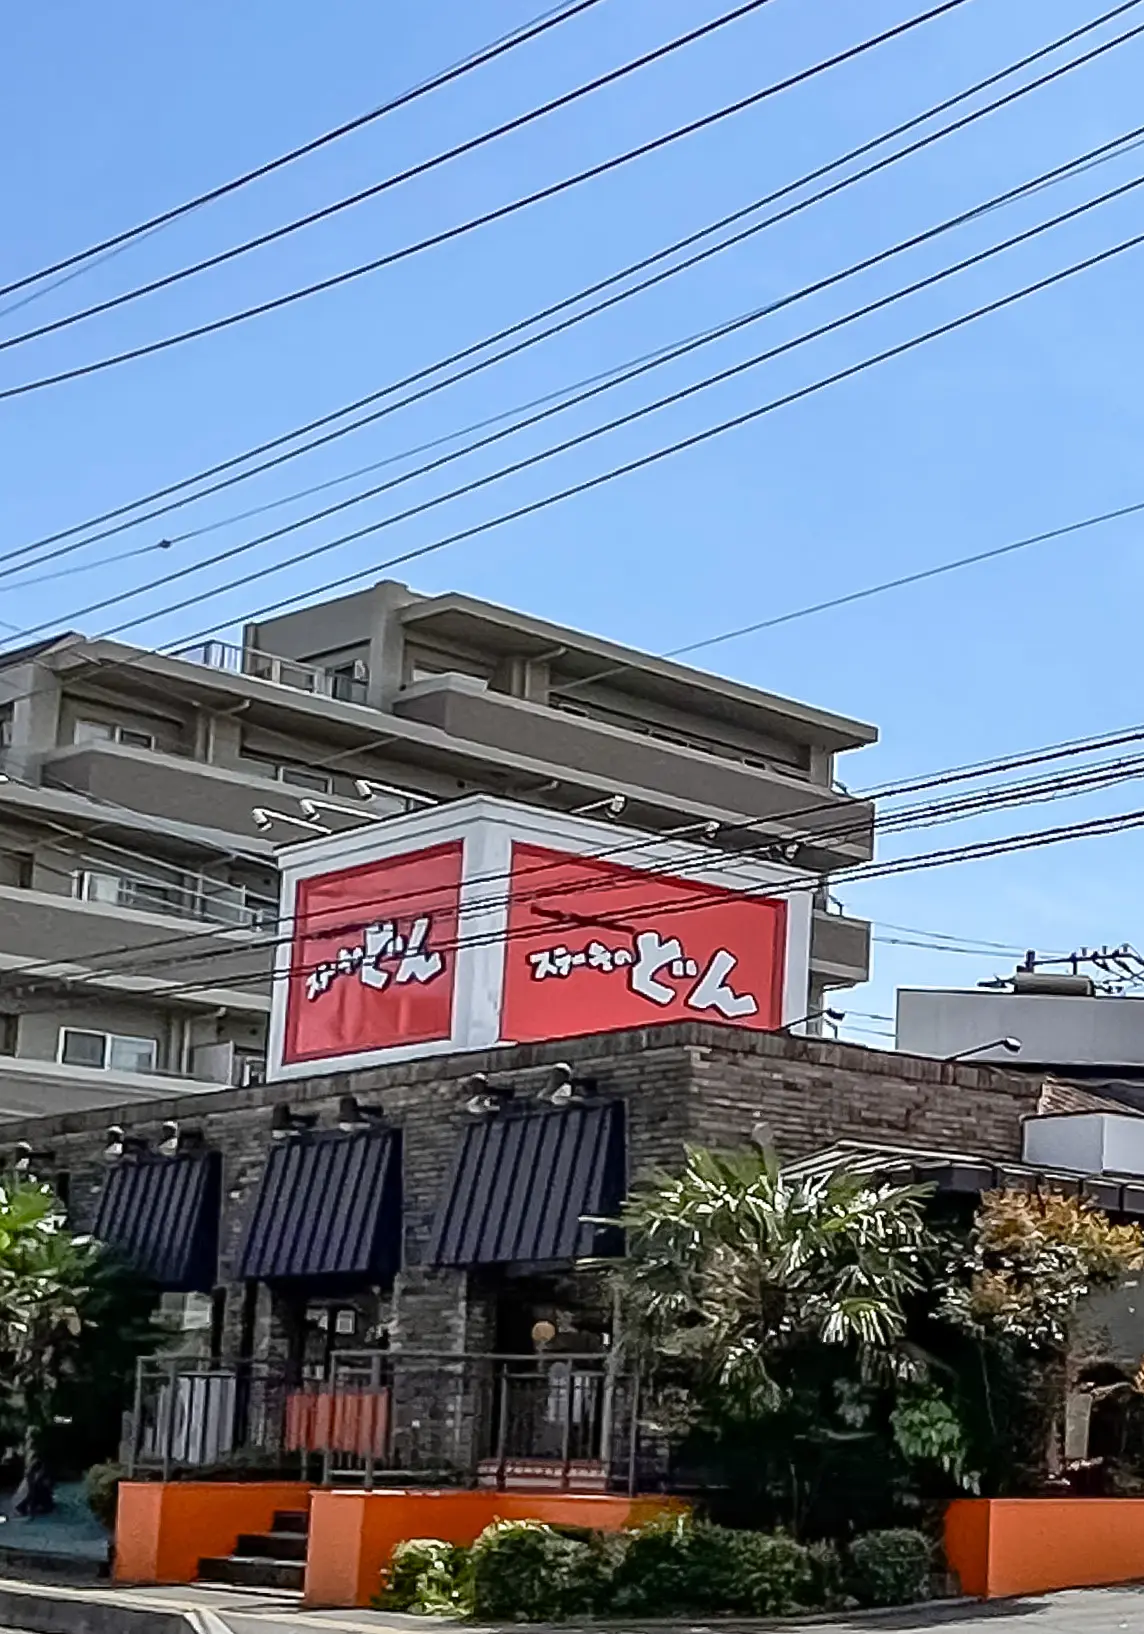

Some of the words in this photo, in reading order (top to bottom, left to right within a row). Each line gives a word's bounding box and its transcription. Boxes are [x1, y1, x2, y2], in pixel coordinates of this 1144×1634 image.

[528, 931, 759, 1018] ステーキのどん
